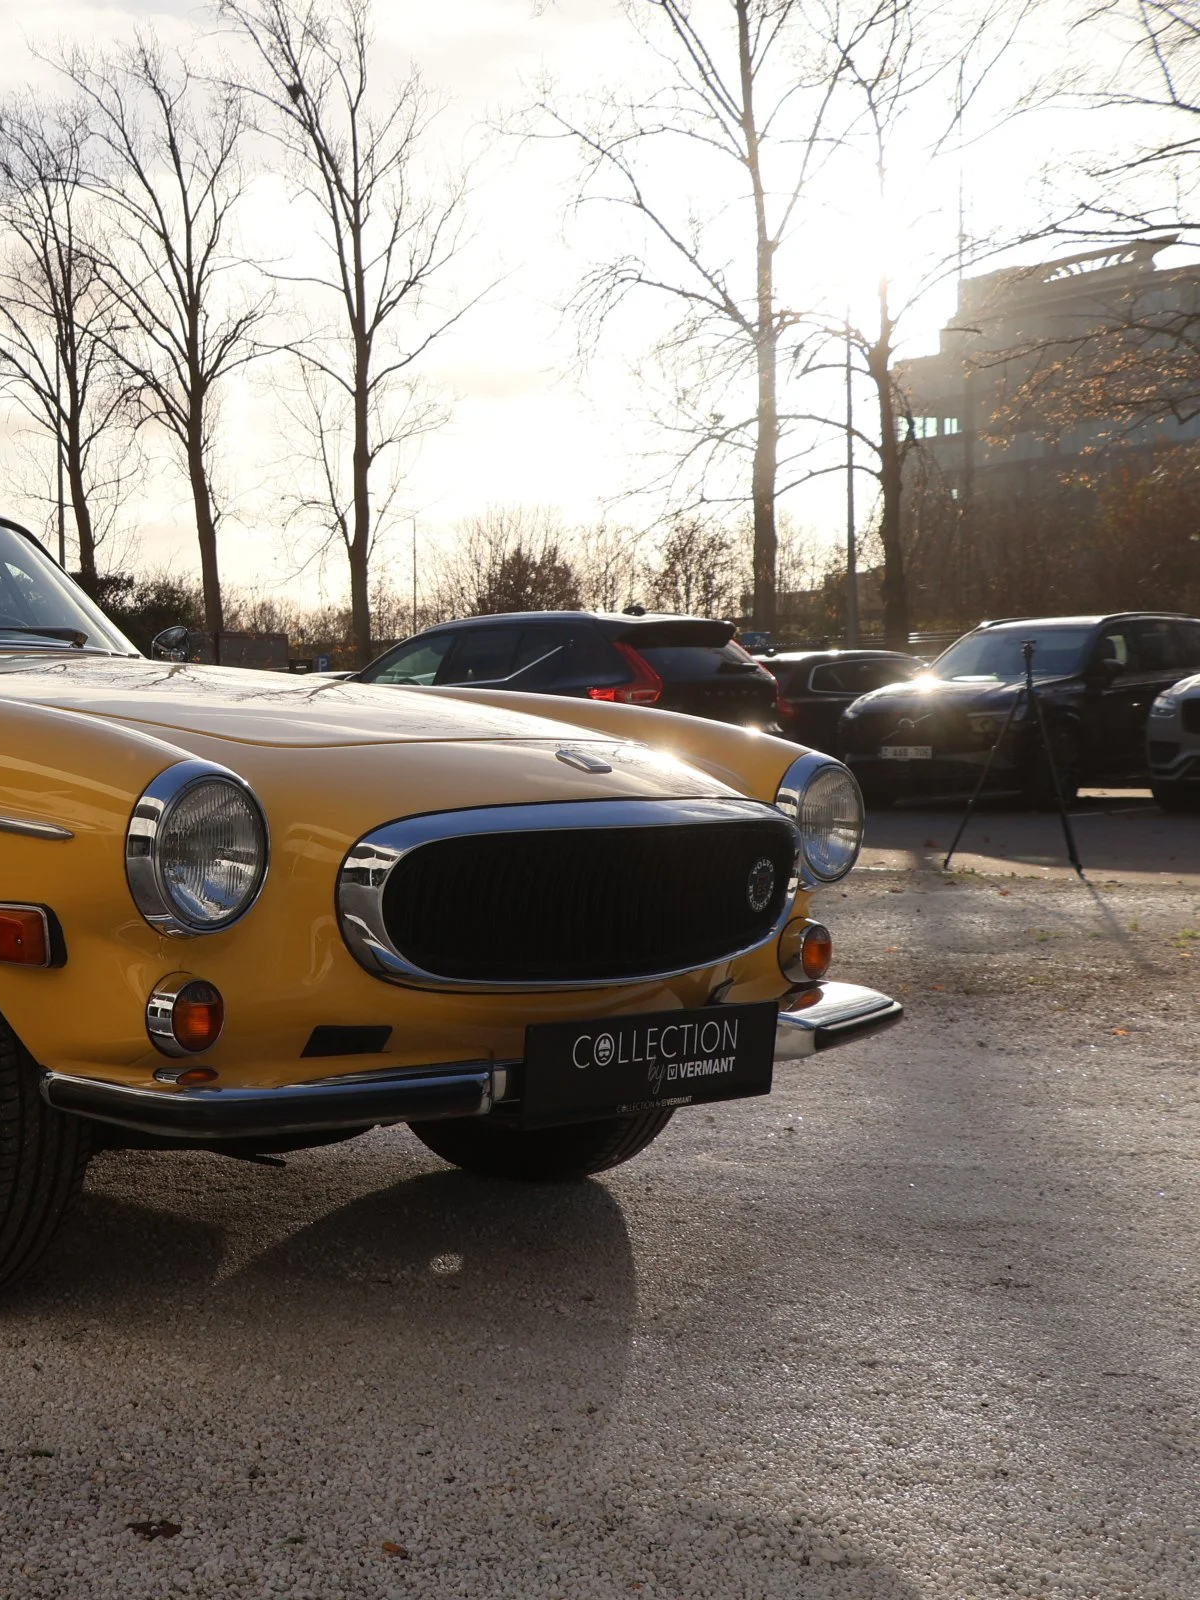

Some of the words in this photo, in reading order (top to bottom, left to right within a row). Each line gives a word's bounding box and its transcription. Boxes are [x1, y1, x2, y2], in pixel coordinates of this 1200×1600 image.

[752, 858, 774, 874] VOLVO
[572, 1018, 739, 1069] COLLECTION
[648, 1056, 666, 1094] by
[679, 1056, 736, 1078] VERMANT
[616, 1100, 655, 1113] COLLECTION
[666, 1096, 693, 1106] VERMANT
